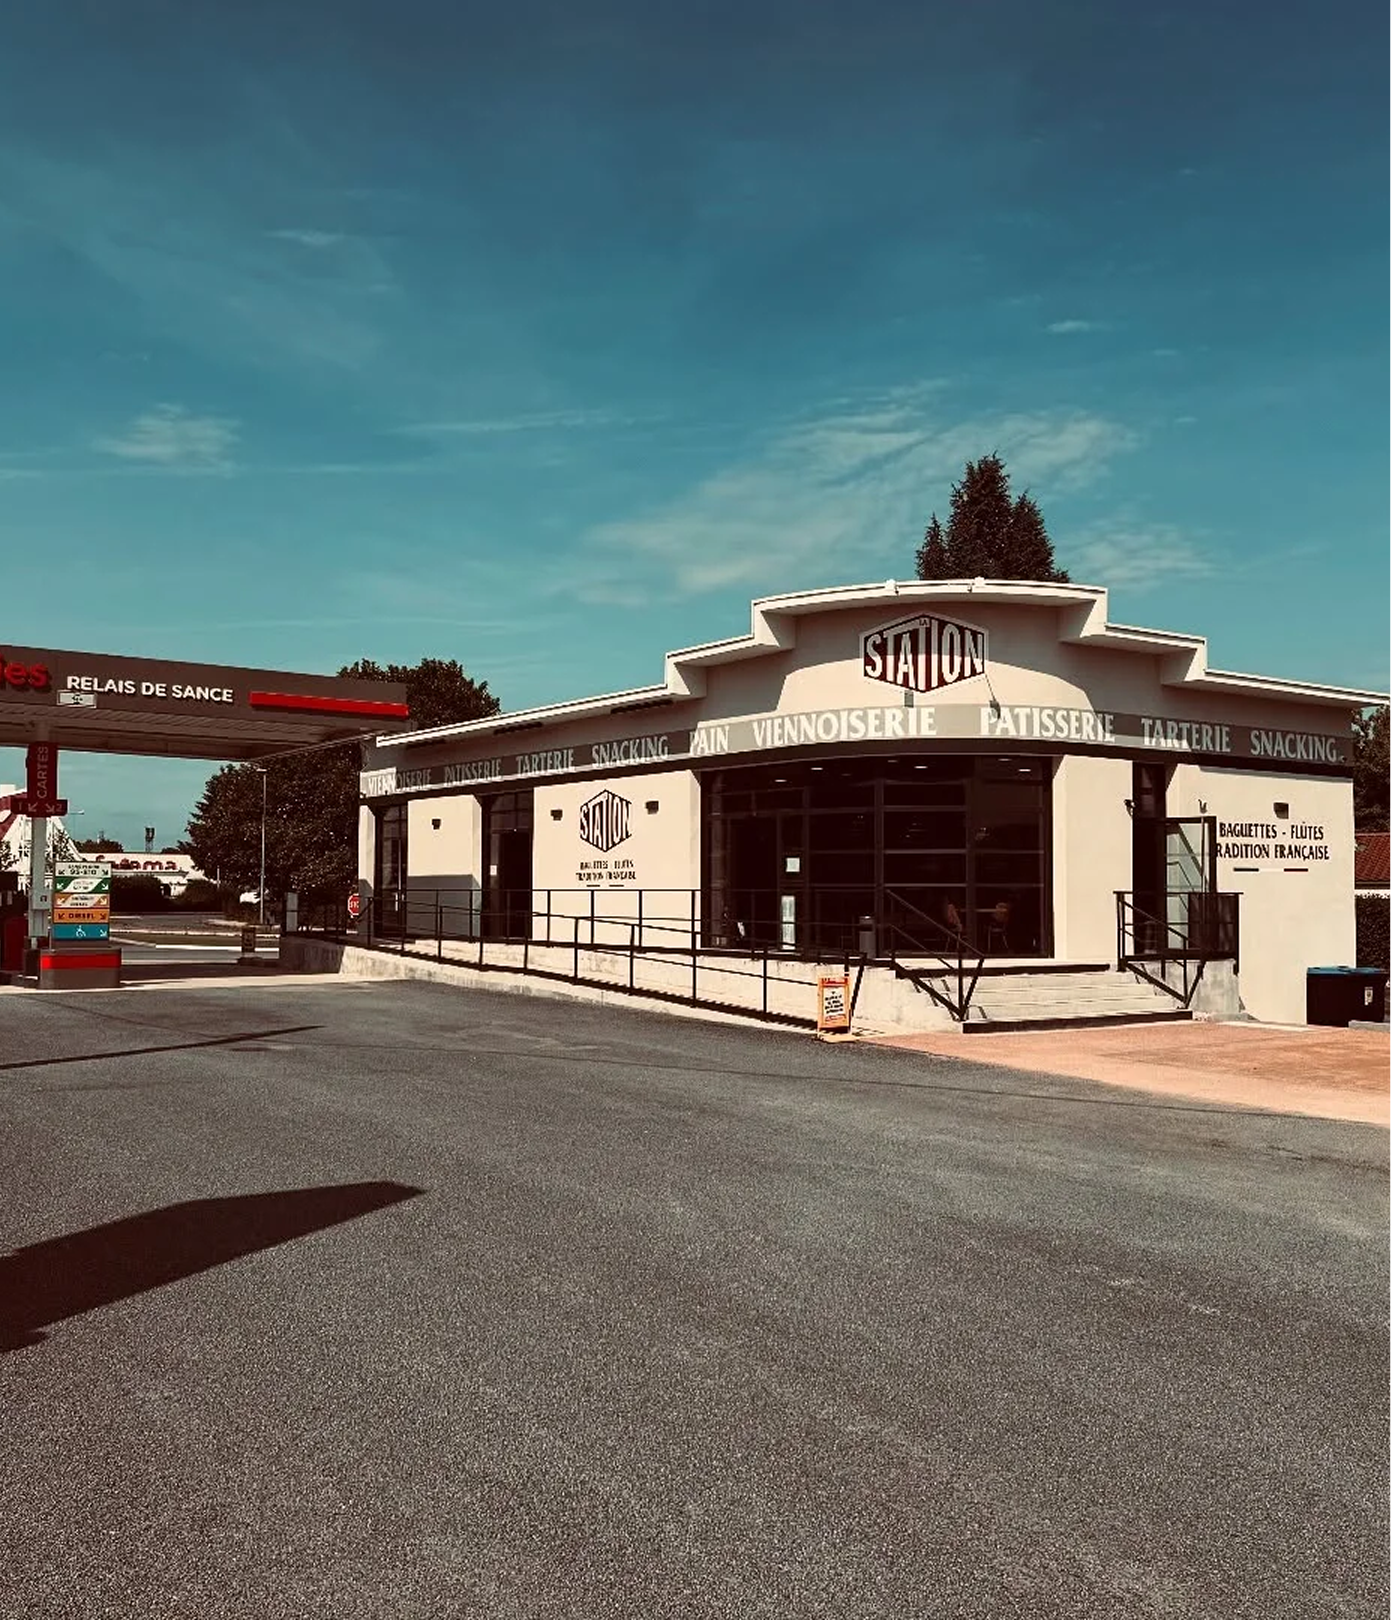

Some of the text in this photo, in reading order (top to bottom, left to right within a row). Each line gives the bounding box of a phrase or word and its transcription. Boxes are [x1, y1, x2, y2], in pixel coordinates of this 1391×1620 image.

[0, 653, 48, 687] es
[865, 618, 983, 690] STATION
[67, 676, 233, 702] RELAIS DE SANCE
[689, 707, 1338, 763] PAIN VIENNOISERIE PATISSERIE TARTERIE SNACKING
[36, 746, 48, 798] CARTES
[443, 758, 502, 787] PATISSERIE
[516, 749, 575, 776] TARTERIE
[591, 736, 669, 768] SNACKING
[580, 790, 632, 850] STATION
[1219, 823, 1277, 839] BAGUETTES
[1216, 843, 1330, 861] RADITION FRANÇAISE
